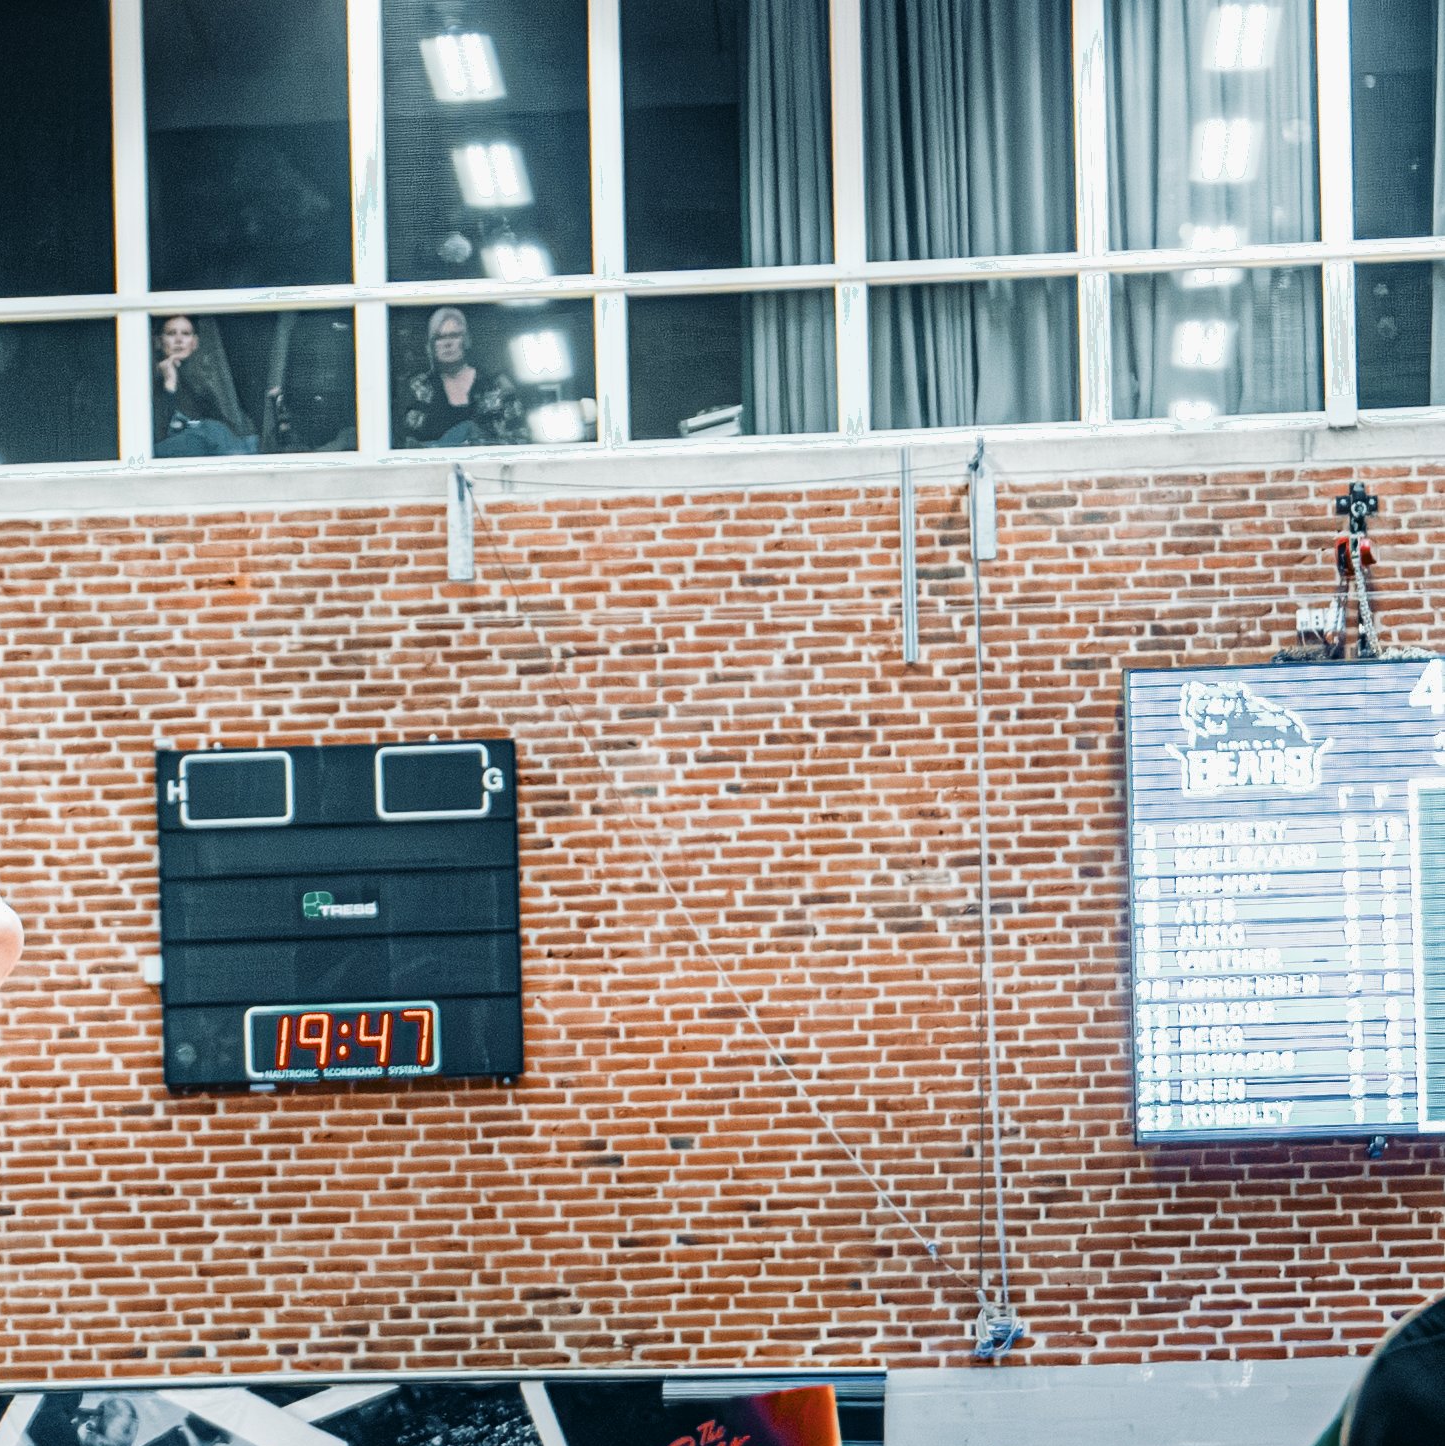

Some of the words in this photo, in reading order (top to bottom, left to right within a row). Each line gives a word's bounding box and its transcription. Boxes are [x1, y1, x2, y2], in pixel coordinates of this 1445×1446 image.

[167, 780, 188, 804] H
[482, 767, 504, 792] G
[275, 1008, 433, 1069] 19:47
[264, 1069, 319, 1079] NAUTRONIC
[323, 1067, 383, 1078] SCOREBOARD
[388, 1065, 423, 1075] SYSTEM
[697, 1418, 726, 1446] The
